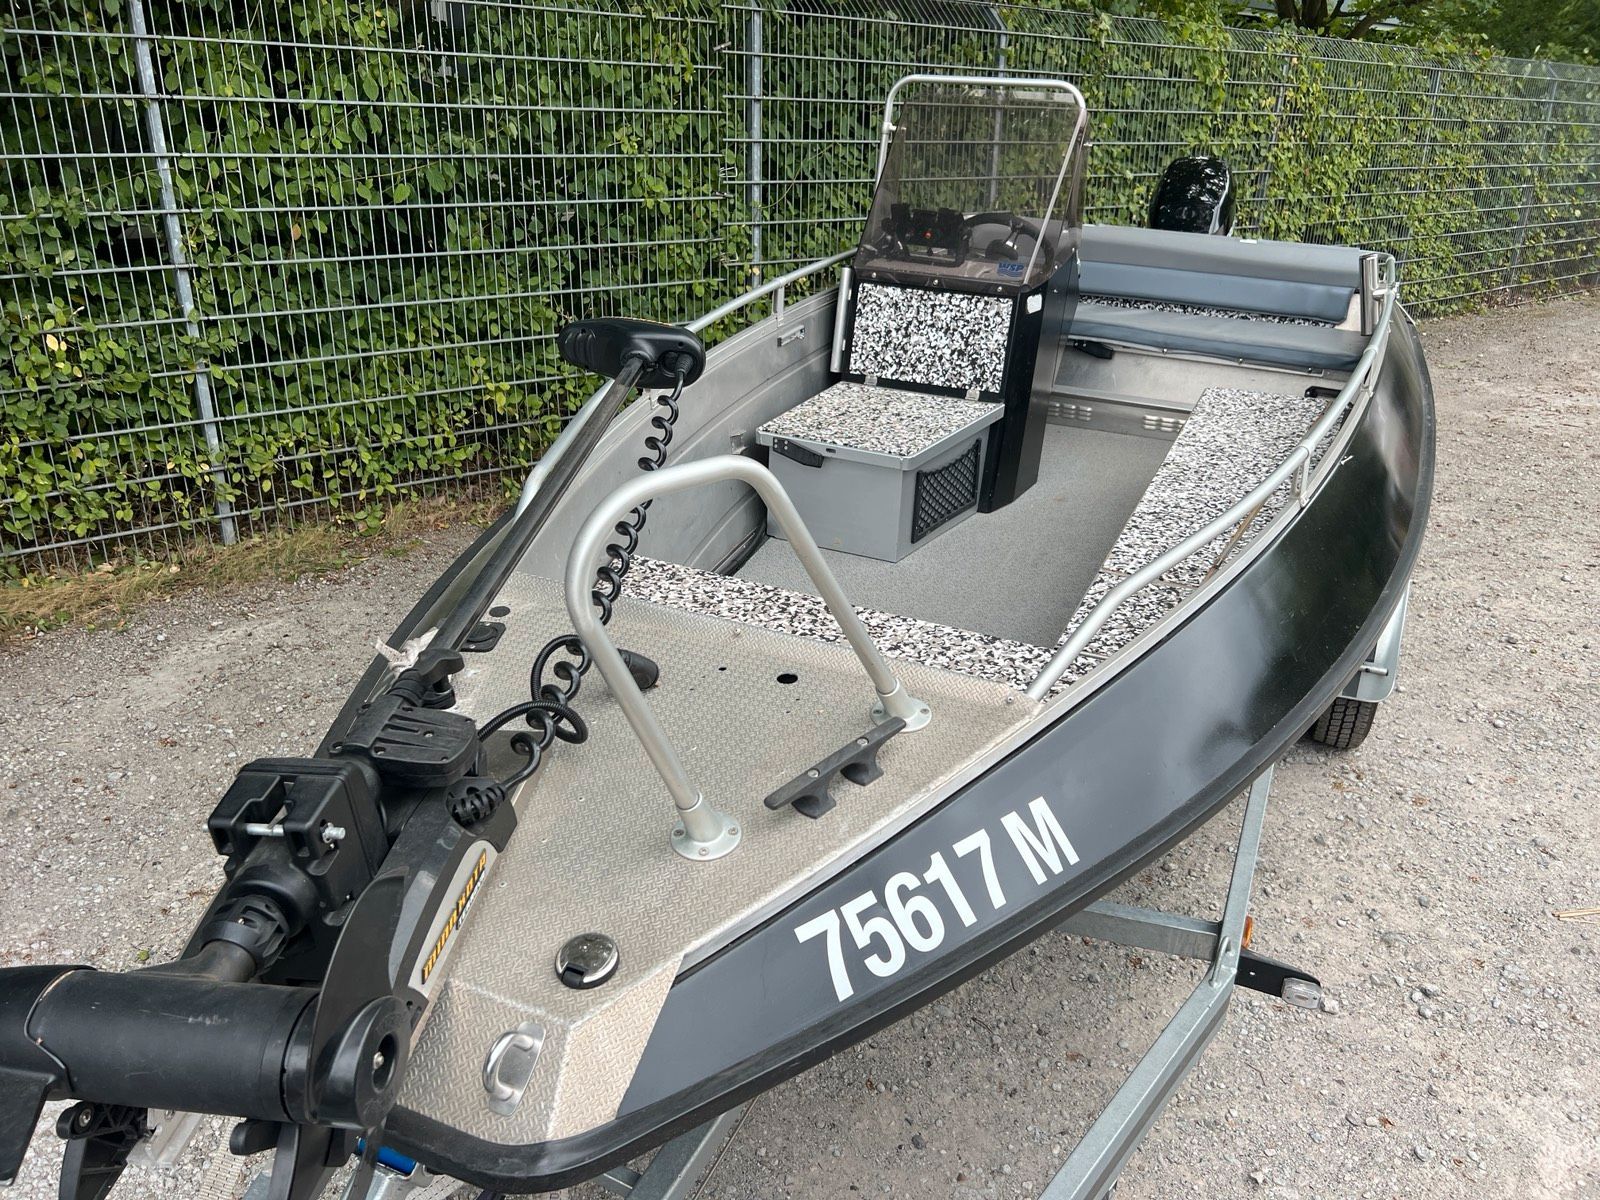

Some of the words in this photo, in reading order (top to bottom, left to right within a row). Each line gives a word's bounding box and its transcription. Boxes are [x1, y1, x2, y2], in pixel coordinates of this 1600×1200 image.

[998, 261, 1025, 272] WSP
[794, 828, 1007, 1002] 75617
[1000, 796, 1080, 886] M
